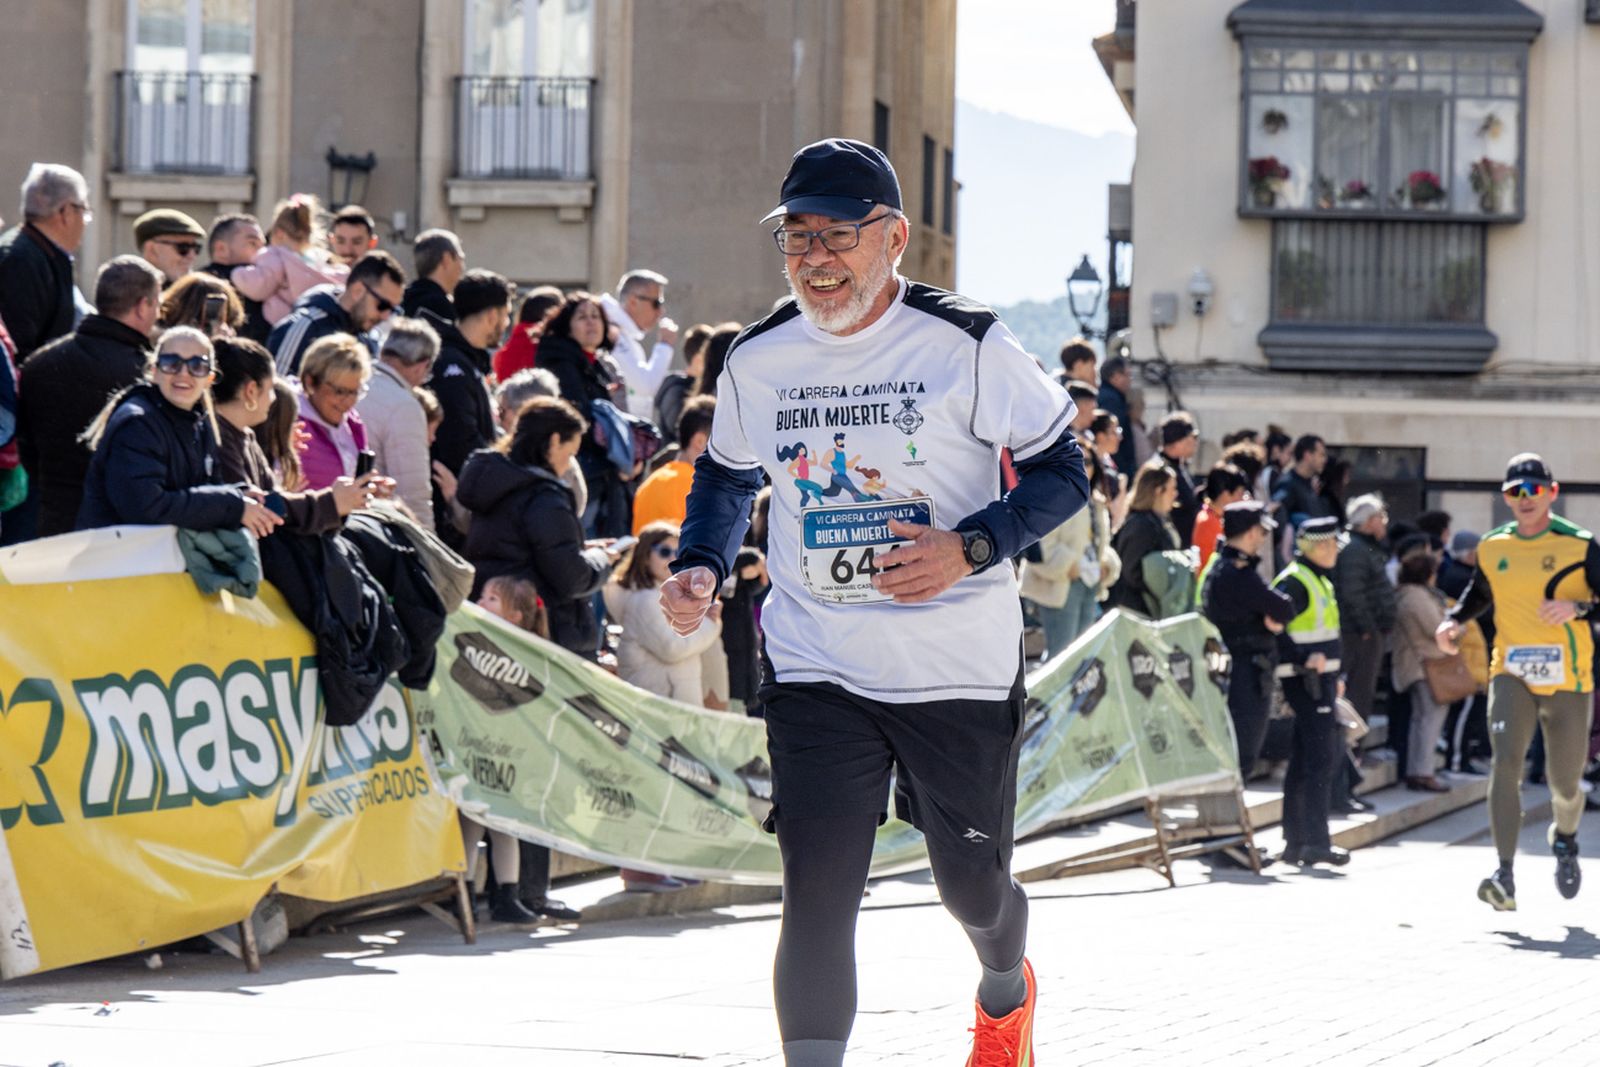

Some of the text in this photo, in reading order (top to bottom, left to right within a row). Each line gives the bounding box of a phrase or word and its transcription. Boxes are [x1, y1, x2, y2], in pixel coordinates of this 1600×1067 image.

[776, 381, 926, 401] VI CARRERA CAMINATA
[776, 403, 890, 431] BUENA MUERTE
[816, 508, 916, 525] VI CARRERA CAMINATA
[815, 525, 895, 544] BUENA MUERTE
[1519, 662, 1549, 678] 546
